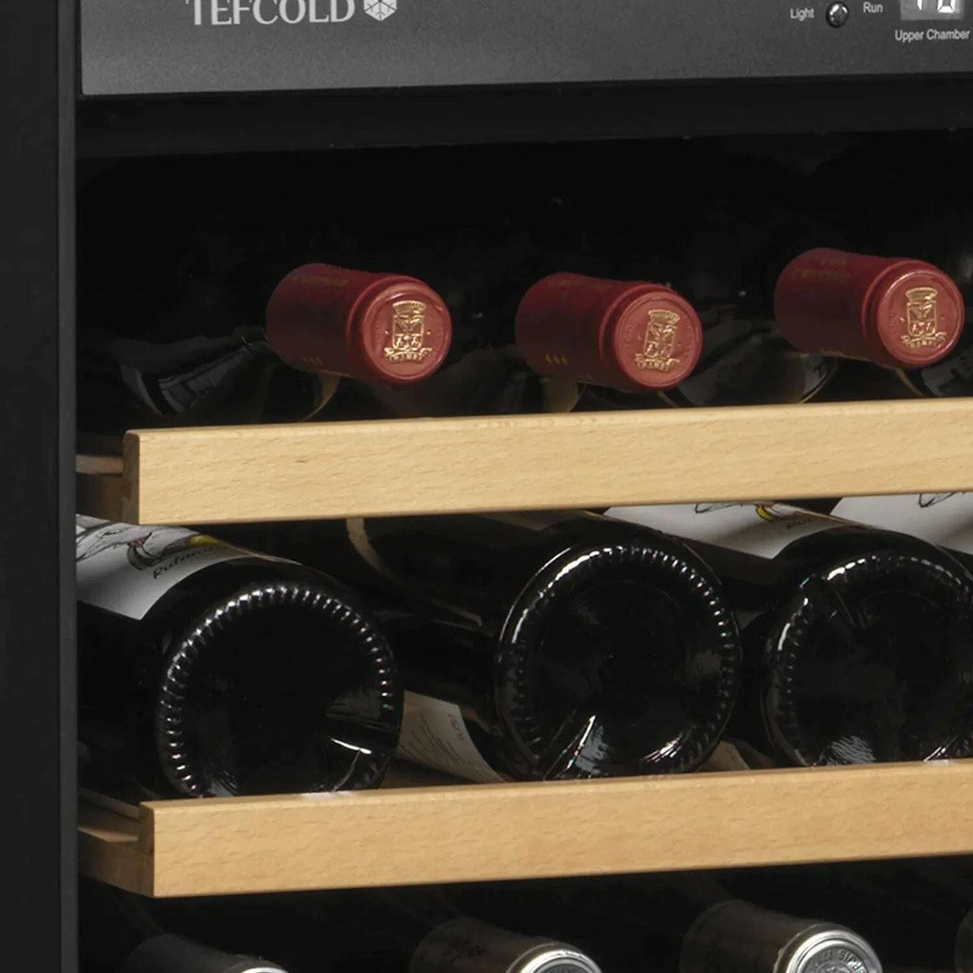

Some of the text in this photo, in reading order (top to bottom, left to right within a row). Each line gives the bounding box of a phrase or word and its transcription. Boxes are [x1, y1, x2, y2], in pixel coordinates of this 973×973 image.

[790, 7, 815, 22] Light
[863, 2, 884, 14] Run
[895, 28, 971, 43] Upper Chamber
